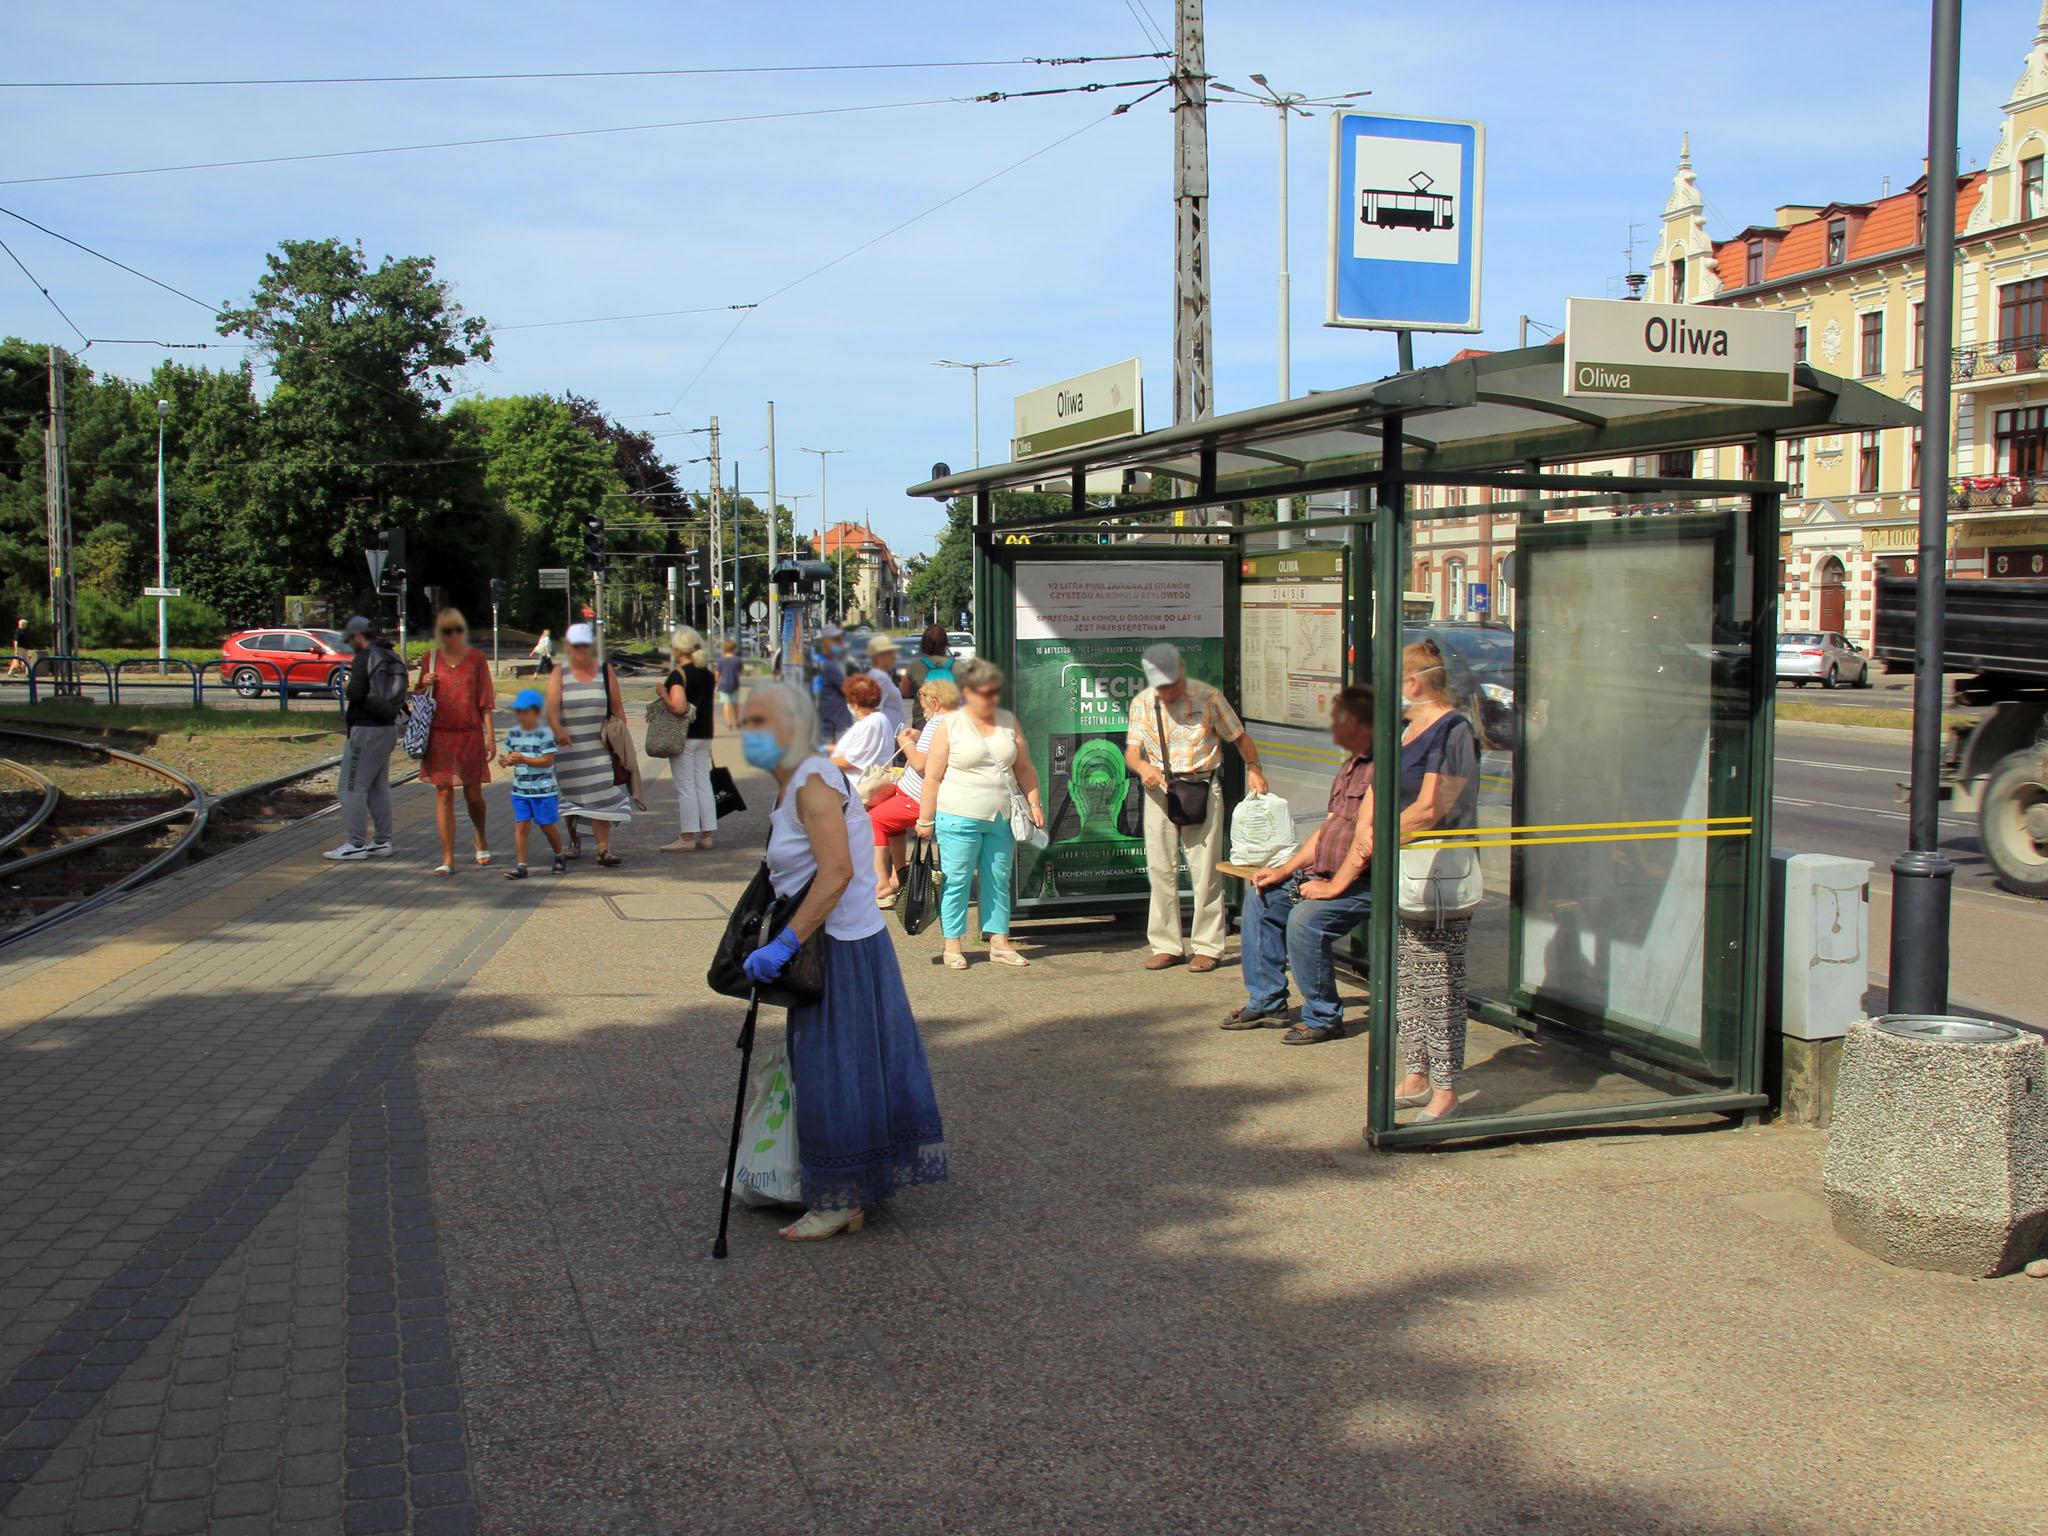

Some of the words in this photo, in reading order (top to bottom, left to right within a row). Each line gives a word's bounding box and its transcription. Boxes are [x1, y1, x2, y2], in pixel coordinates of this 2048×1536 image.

[1645, 316, 1729, 356] Oliwa
[1578, 367, 1631, 389] Oliwa
[1057, 391, 1084, 418] Oliwa
[1017, 440, 1032, 455] Oliwa
[1278, 560, 1299, 573] OLIWA
[1060, 581, 1084, 590] LITRA
[1049, 591, 1094, 600] CZYSTEGO
[1163, 613, 1176, 622] DO
[1177, 613, 1191, 621] LAT
[1073, 624, 1094, 632] JEST
[1069, 678, 1078, 712] 2020
[1081, 677, 1145, 699] LECH
[1081, 701, 1130, 713] MUSI
